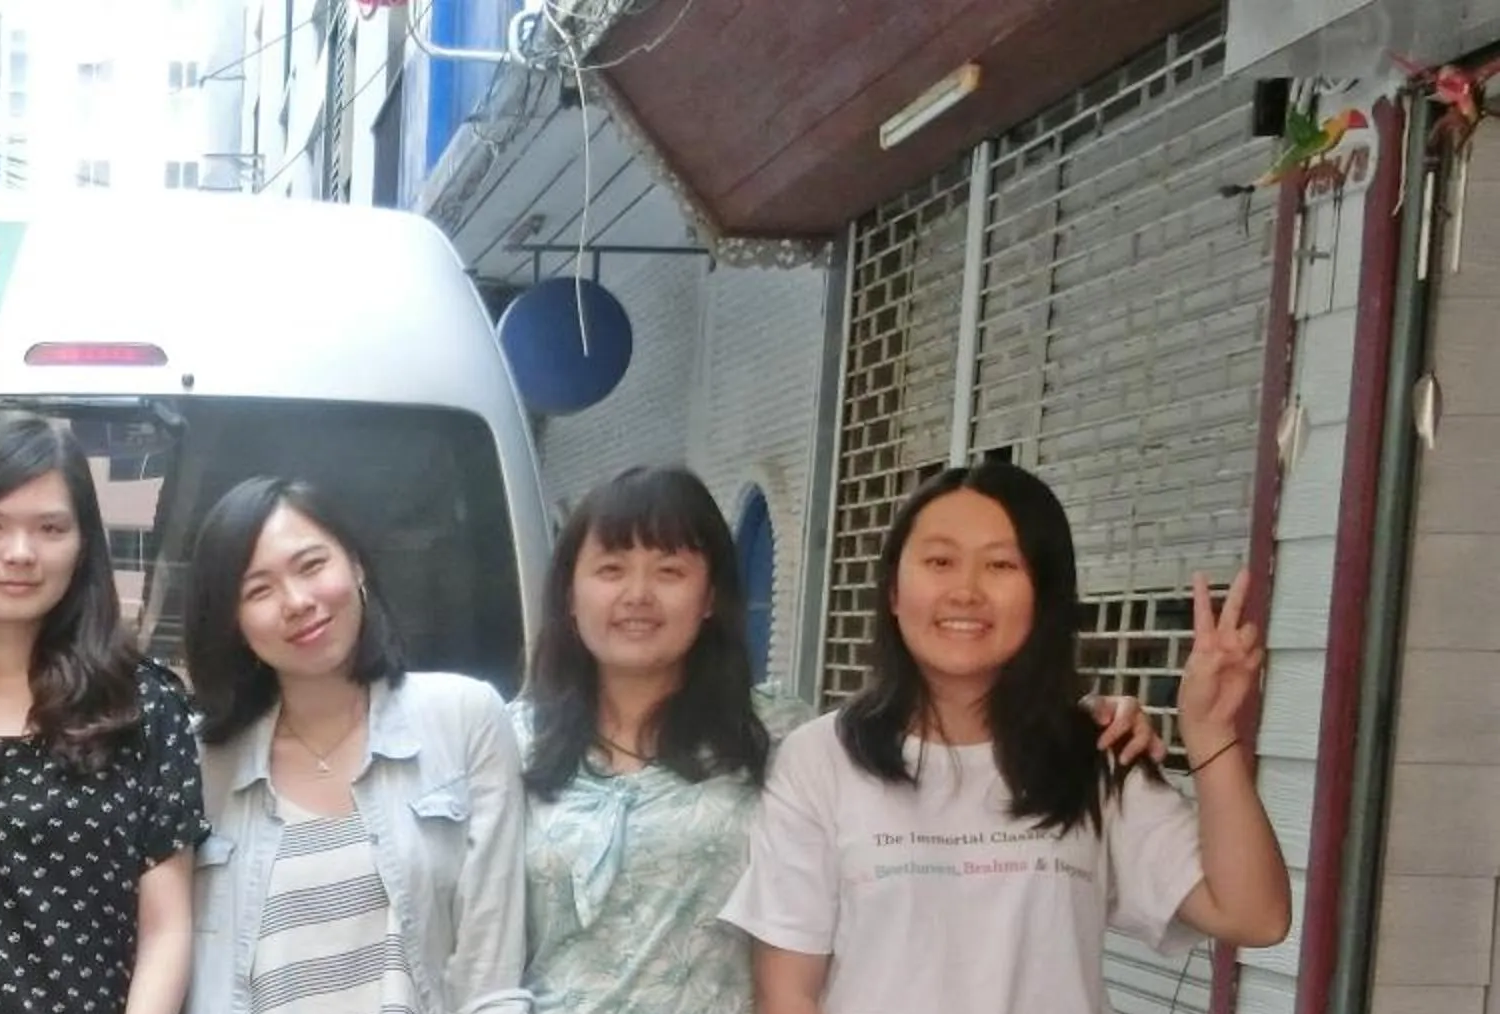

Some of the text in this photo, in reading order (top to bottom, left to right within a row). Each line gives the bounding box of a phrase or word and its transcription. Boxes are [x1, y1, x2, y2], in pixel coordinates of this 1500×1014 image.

[873, 832, 903, 846] The
[910, 831, 984, 845] Immortal
[963, 860, 1028, 875] Brahms
[1035, 857, 1047, 871] &
